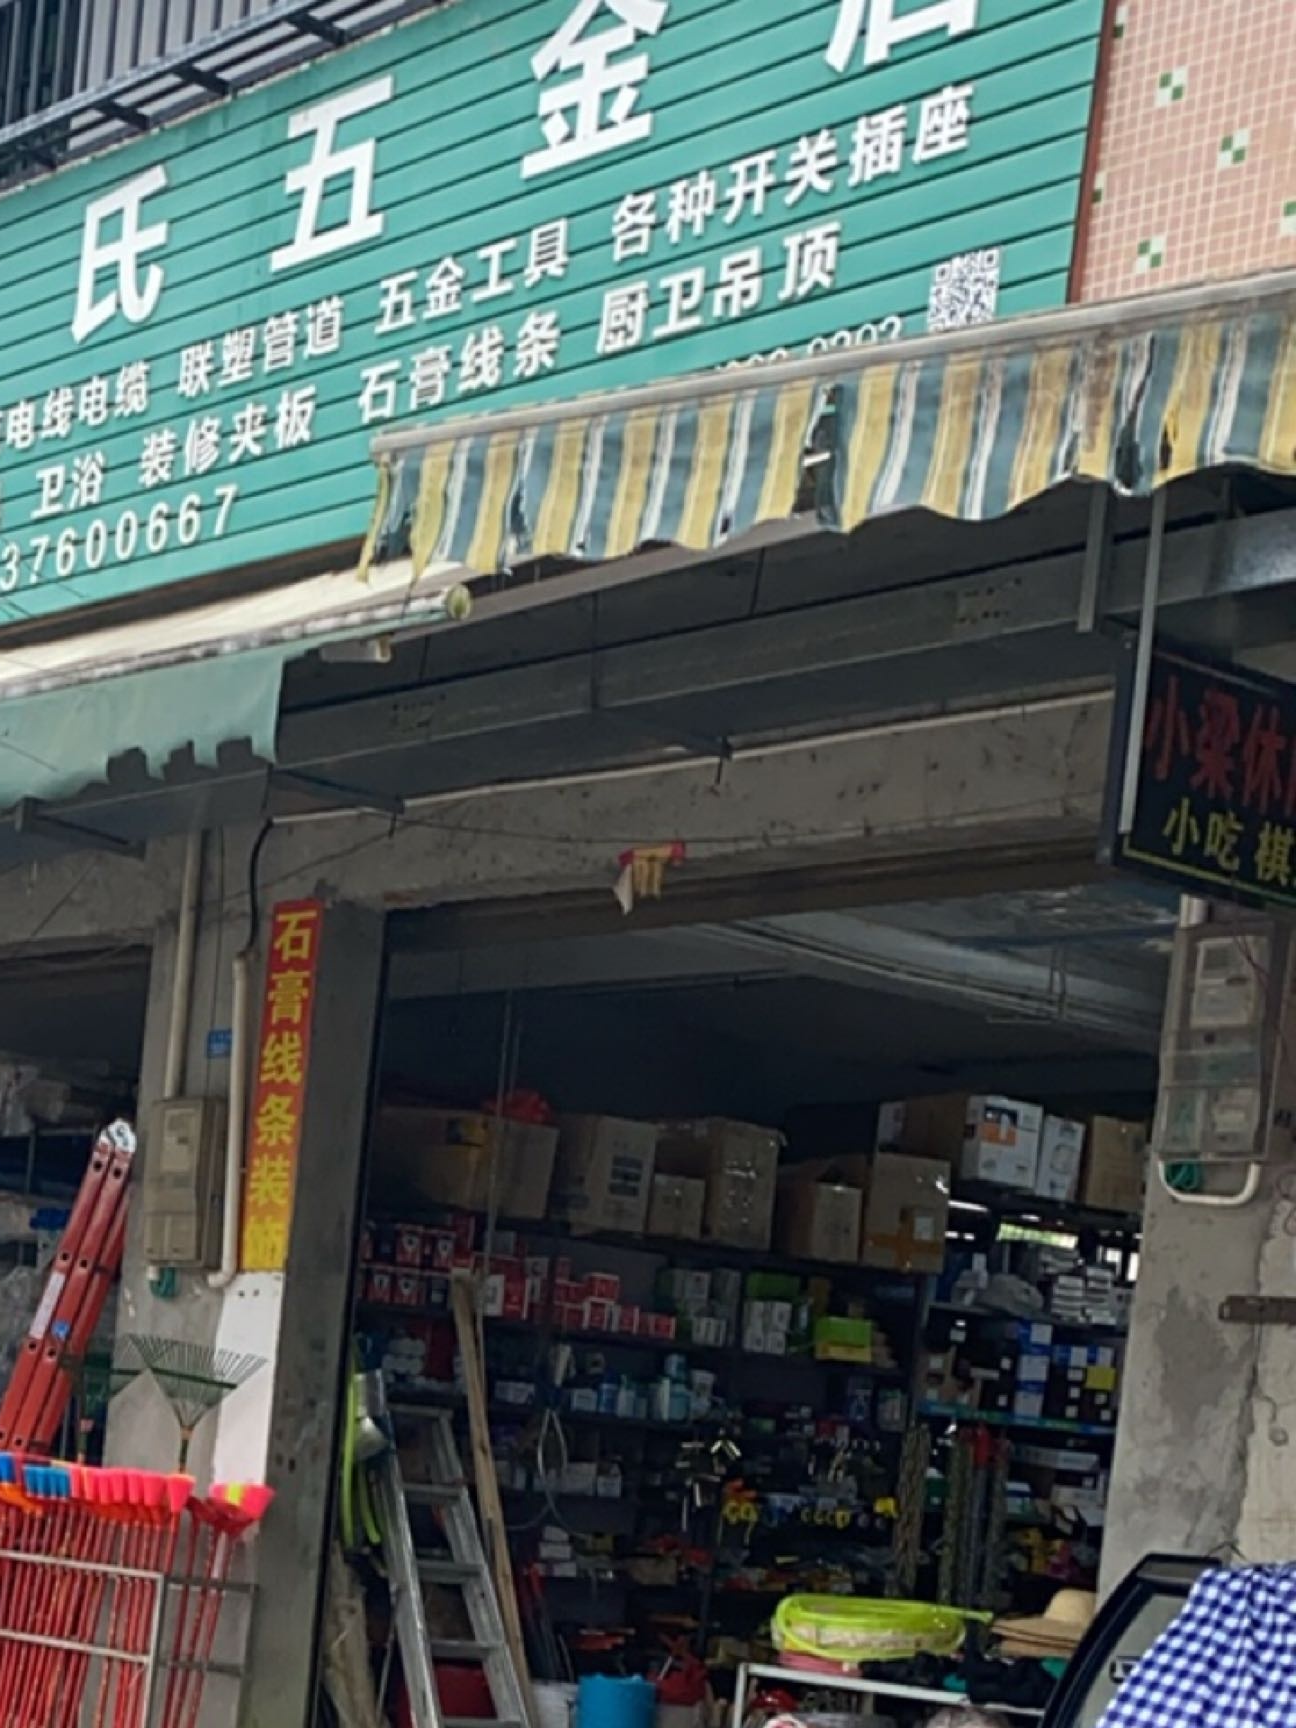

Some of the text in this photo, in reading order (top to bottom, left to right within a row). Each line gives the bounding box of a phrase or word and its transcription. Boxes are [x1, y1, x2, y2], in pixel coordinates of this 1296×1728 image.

[30, 450, 105, 519] 卫浴
[138, 385, 317, 489] 装修夹板
[358, 311, 561, 421] 石膏线条
[596, 221, 842, 356] 厨卫吊顶
[177, 297, 343, 398] 联塑管道
[377, 219, 571, 335] 五金工具
[611, 83, 975, 262] 各种开关插座
[244, 909, 319, 1268] 石膏线条装饰
